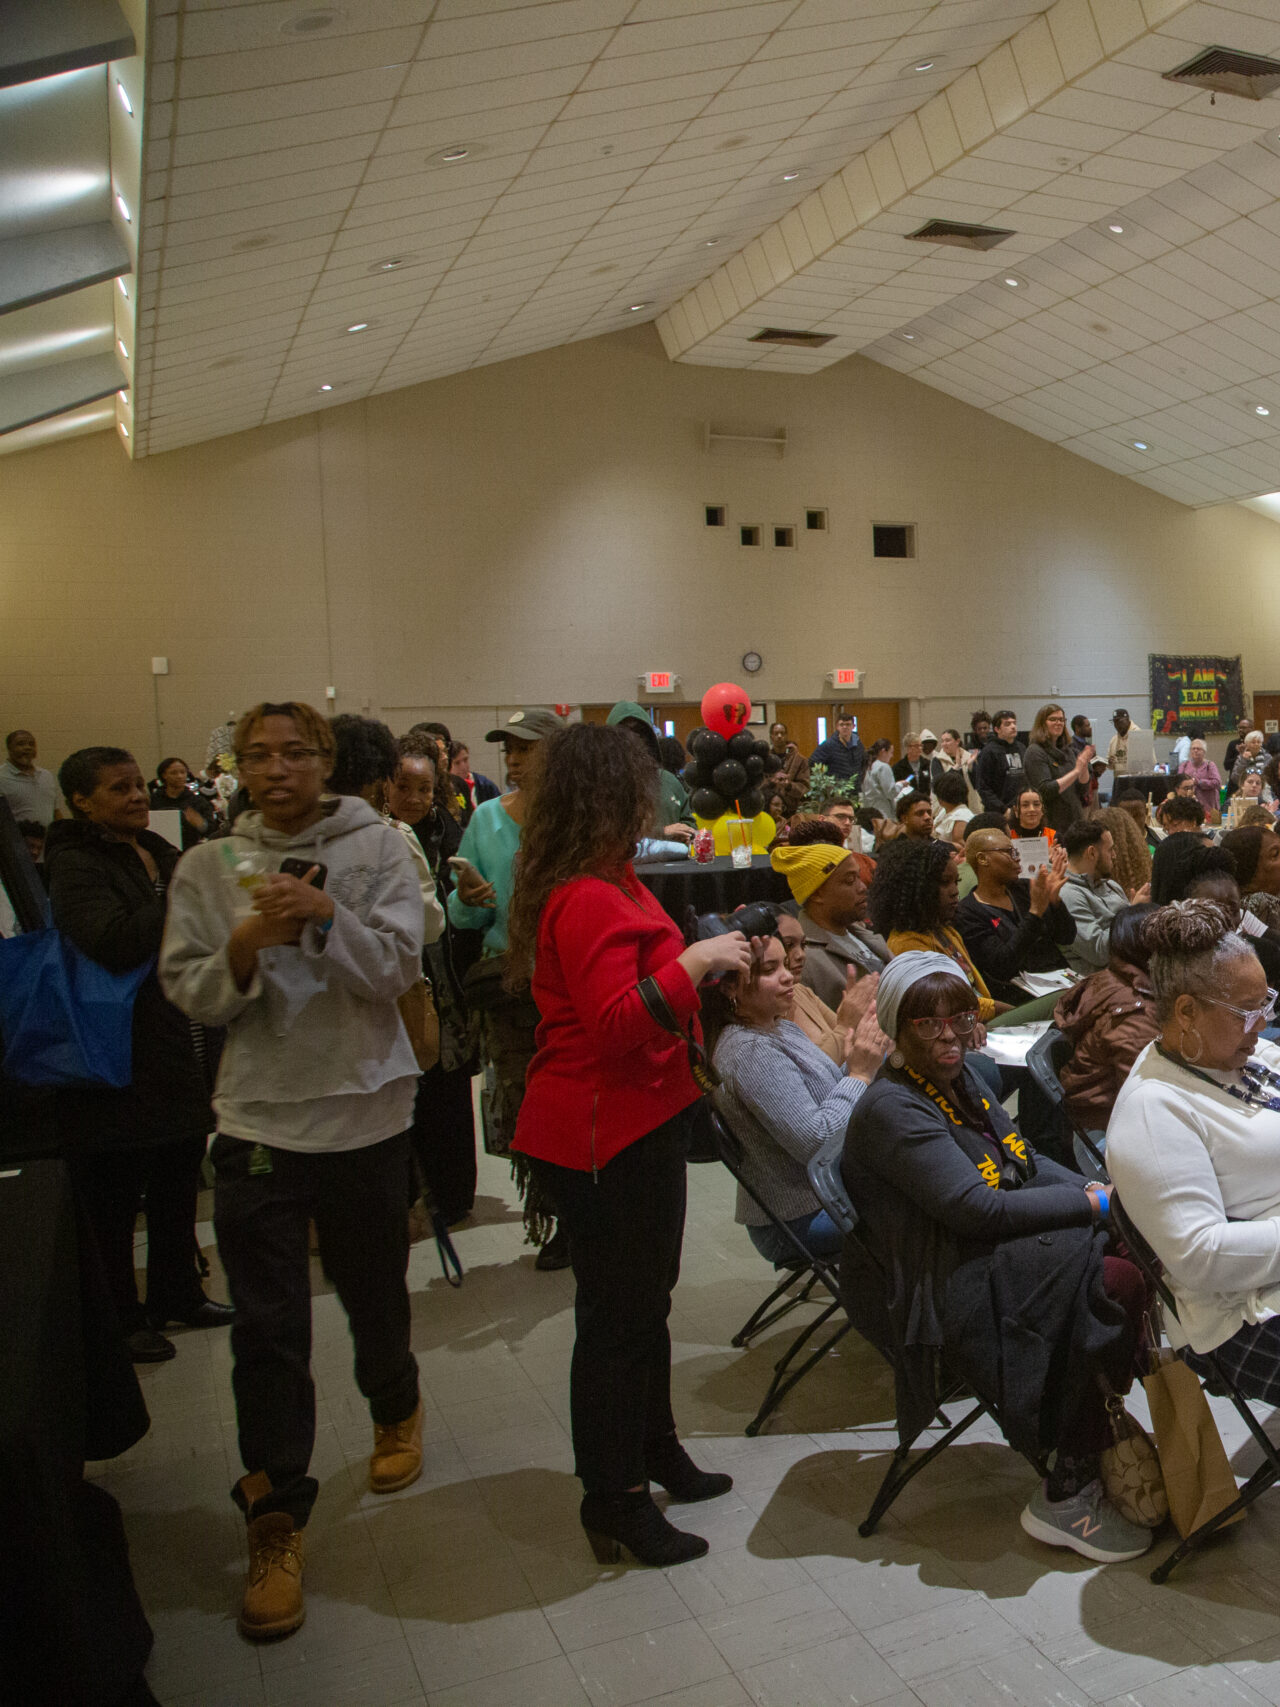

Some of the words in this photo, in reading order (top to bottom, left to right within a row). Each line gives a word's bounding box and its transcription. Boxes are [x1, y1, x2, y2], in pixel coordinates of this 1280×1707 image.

[651, 672, 670, 688] EXIT
[837, 669, 855, 684] EXIT
[1182, 668, 1188, 687] I
[1192, 668, 1216, 687] AM
[1186, 691, 1213, 702] BLACK
[1071, 1515, 1102, 1538] N
